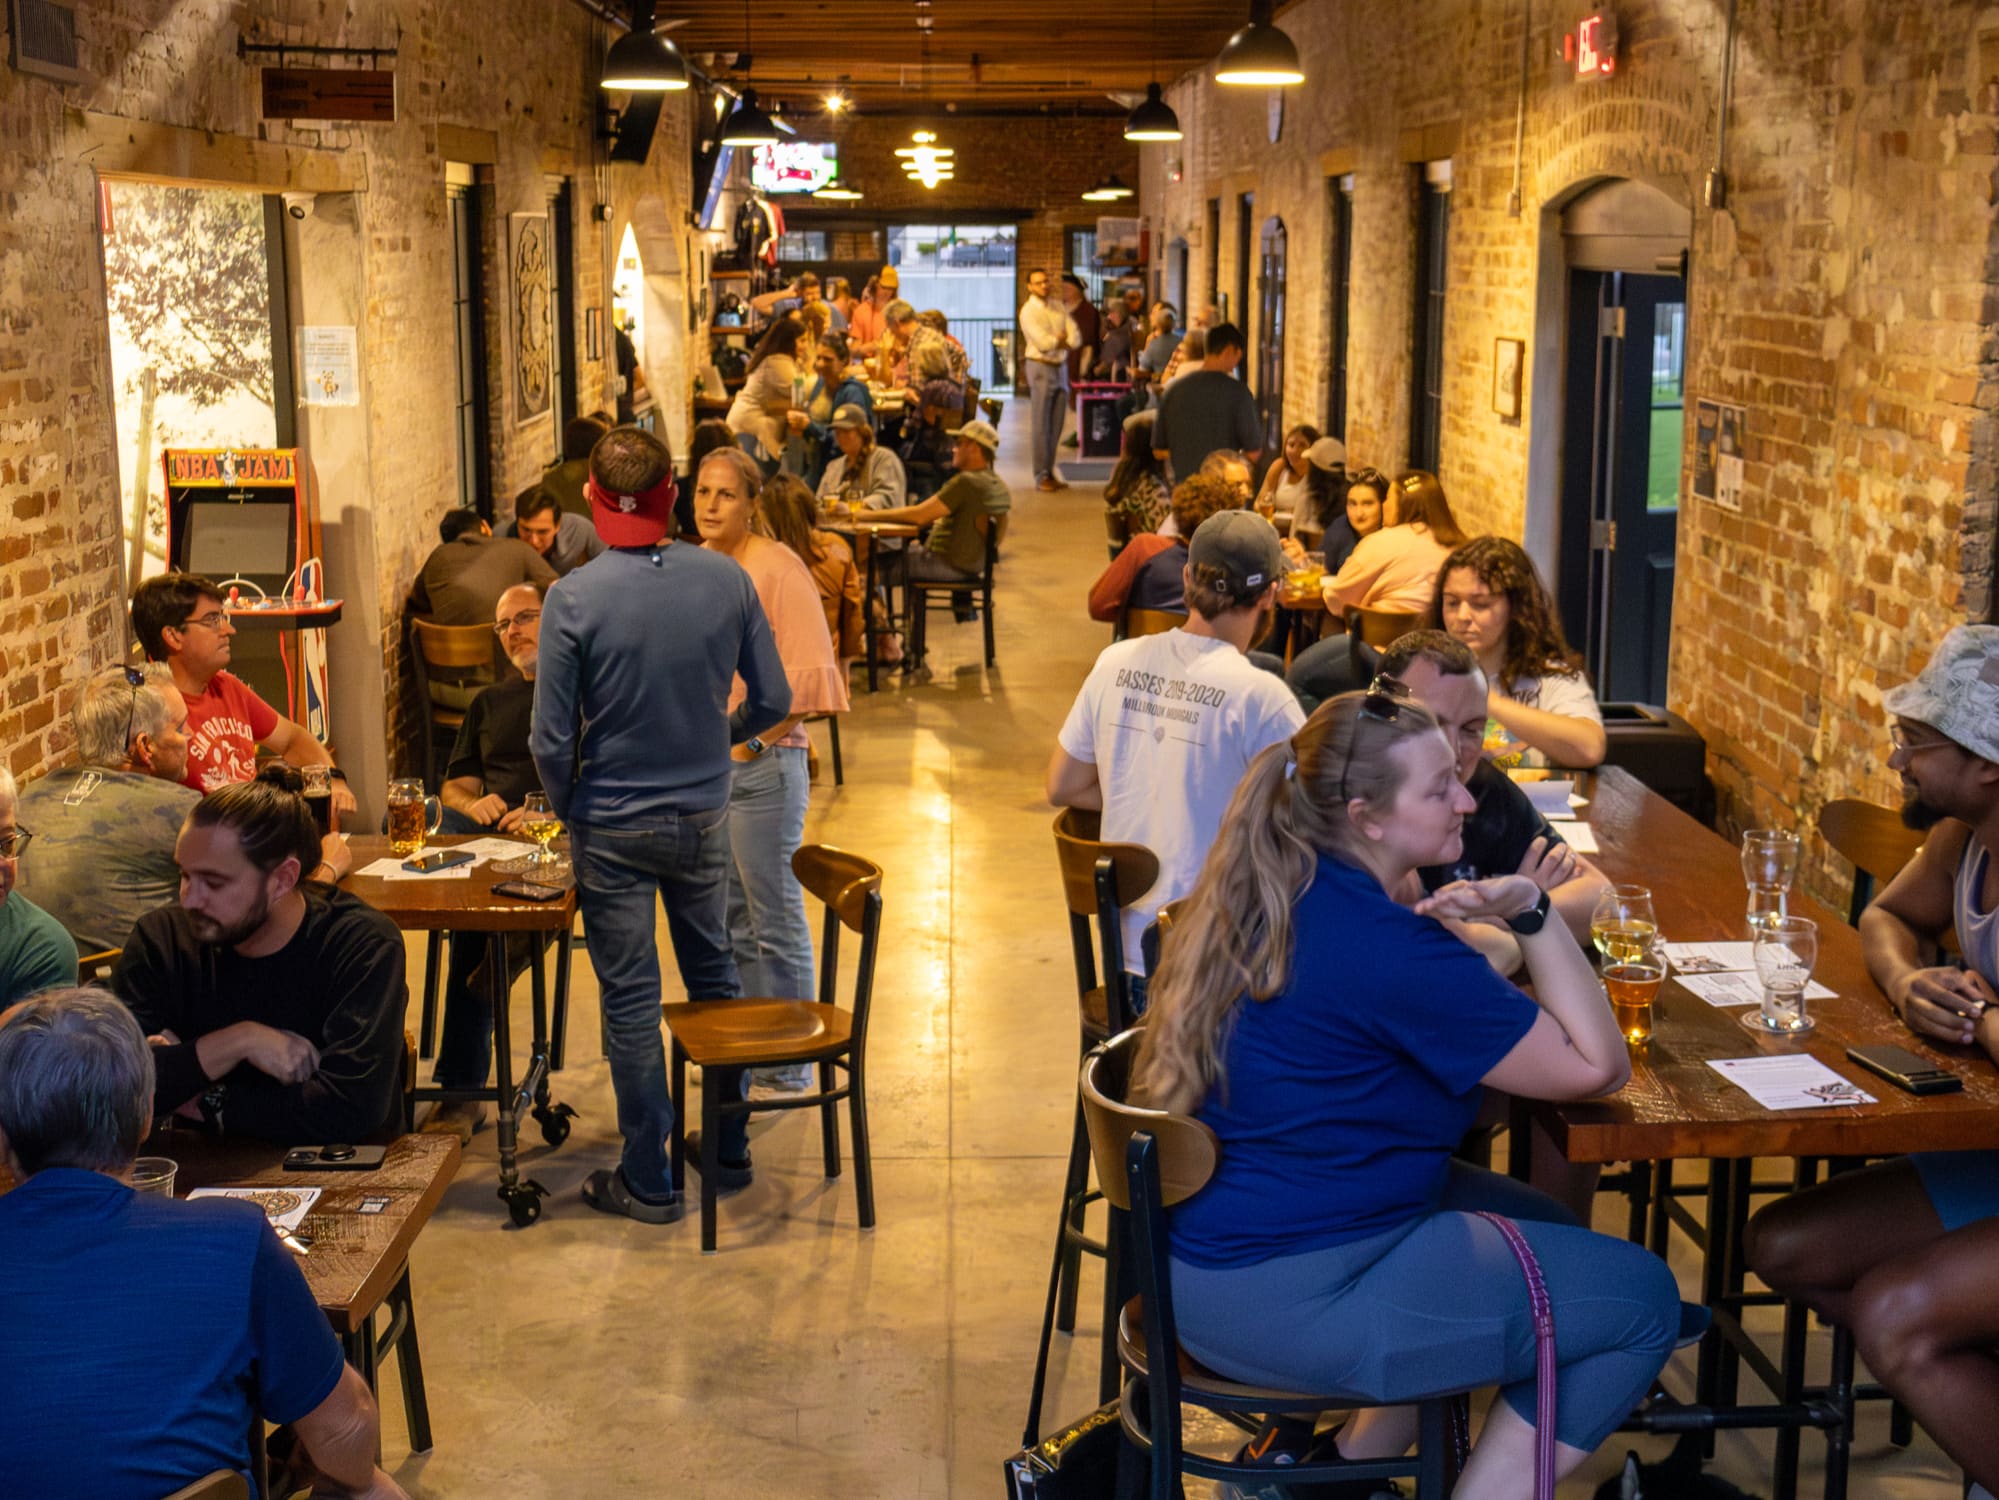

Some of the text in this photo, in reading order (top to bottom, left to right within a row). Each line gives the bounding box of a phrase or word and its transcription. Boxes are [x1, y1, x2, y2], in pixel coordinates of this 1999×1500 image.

[175, 454, 288, 480] NBA JAM
[1115, 668, 1226, 708] BASSES 219-2020
[190, 716, 254, 761] SAN FRACICO
